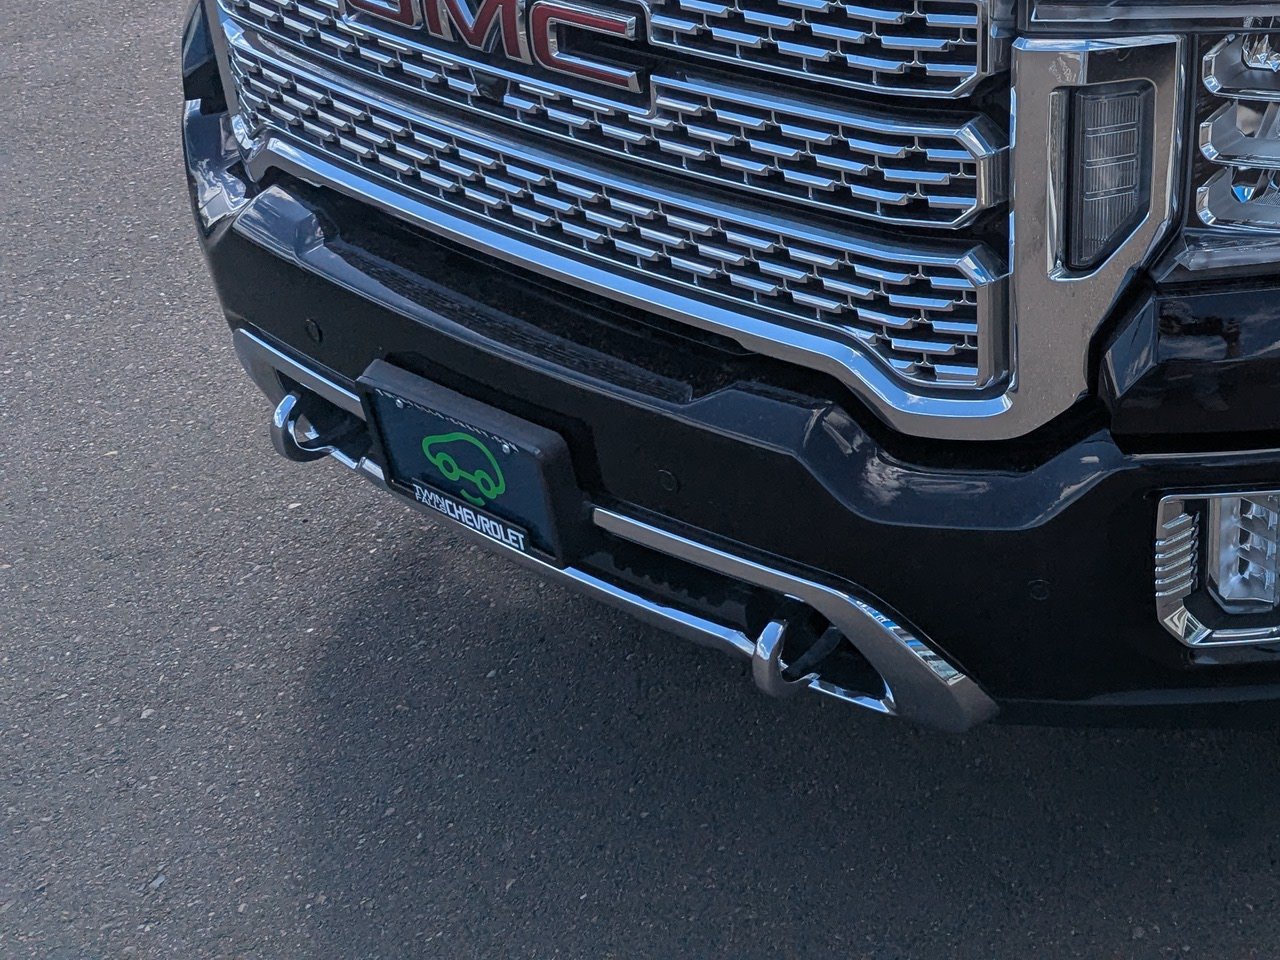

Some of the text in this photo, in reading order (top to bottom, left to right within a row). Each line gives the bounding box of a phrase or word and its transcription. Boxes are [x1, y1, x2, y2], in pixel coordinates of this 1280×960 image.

[412, 483, 446, 506] TWIN
[414, 492, 448, 514] FALLS
[444, 499, 525, 551] CHEVROLET
